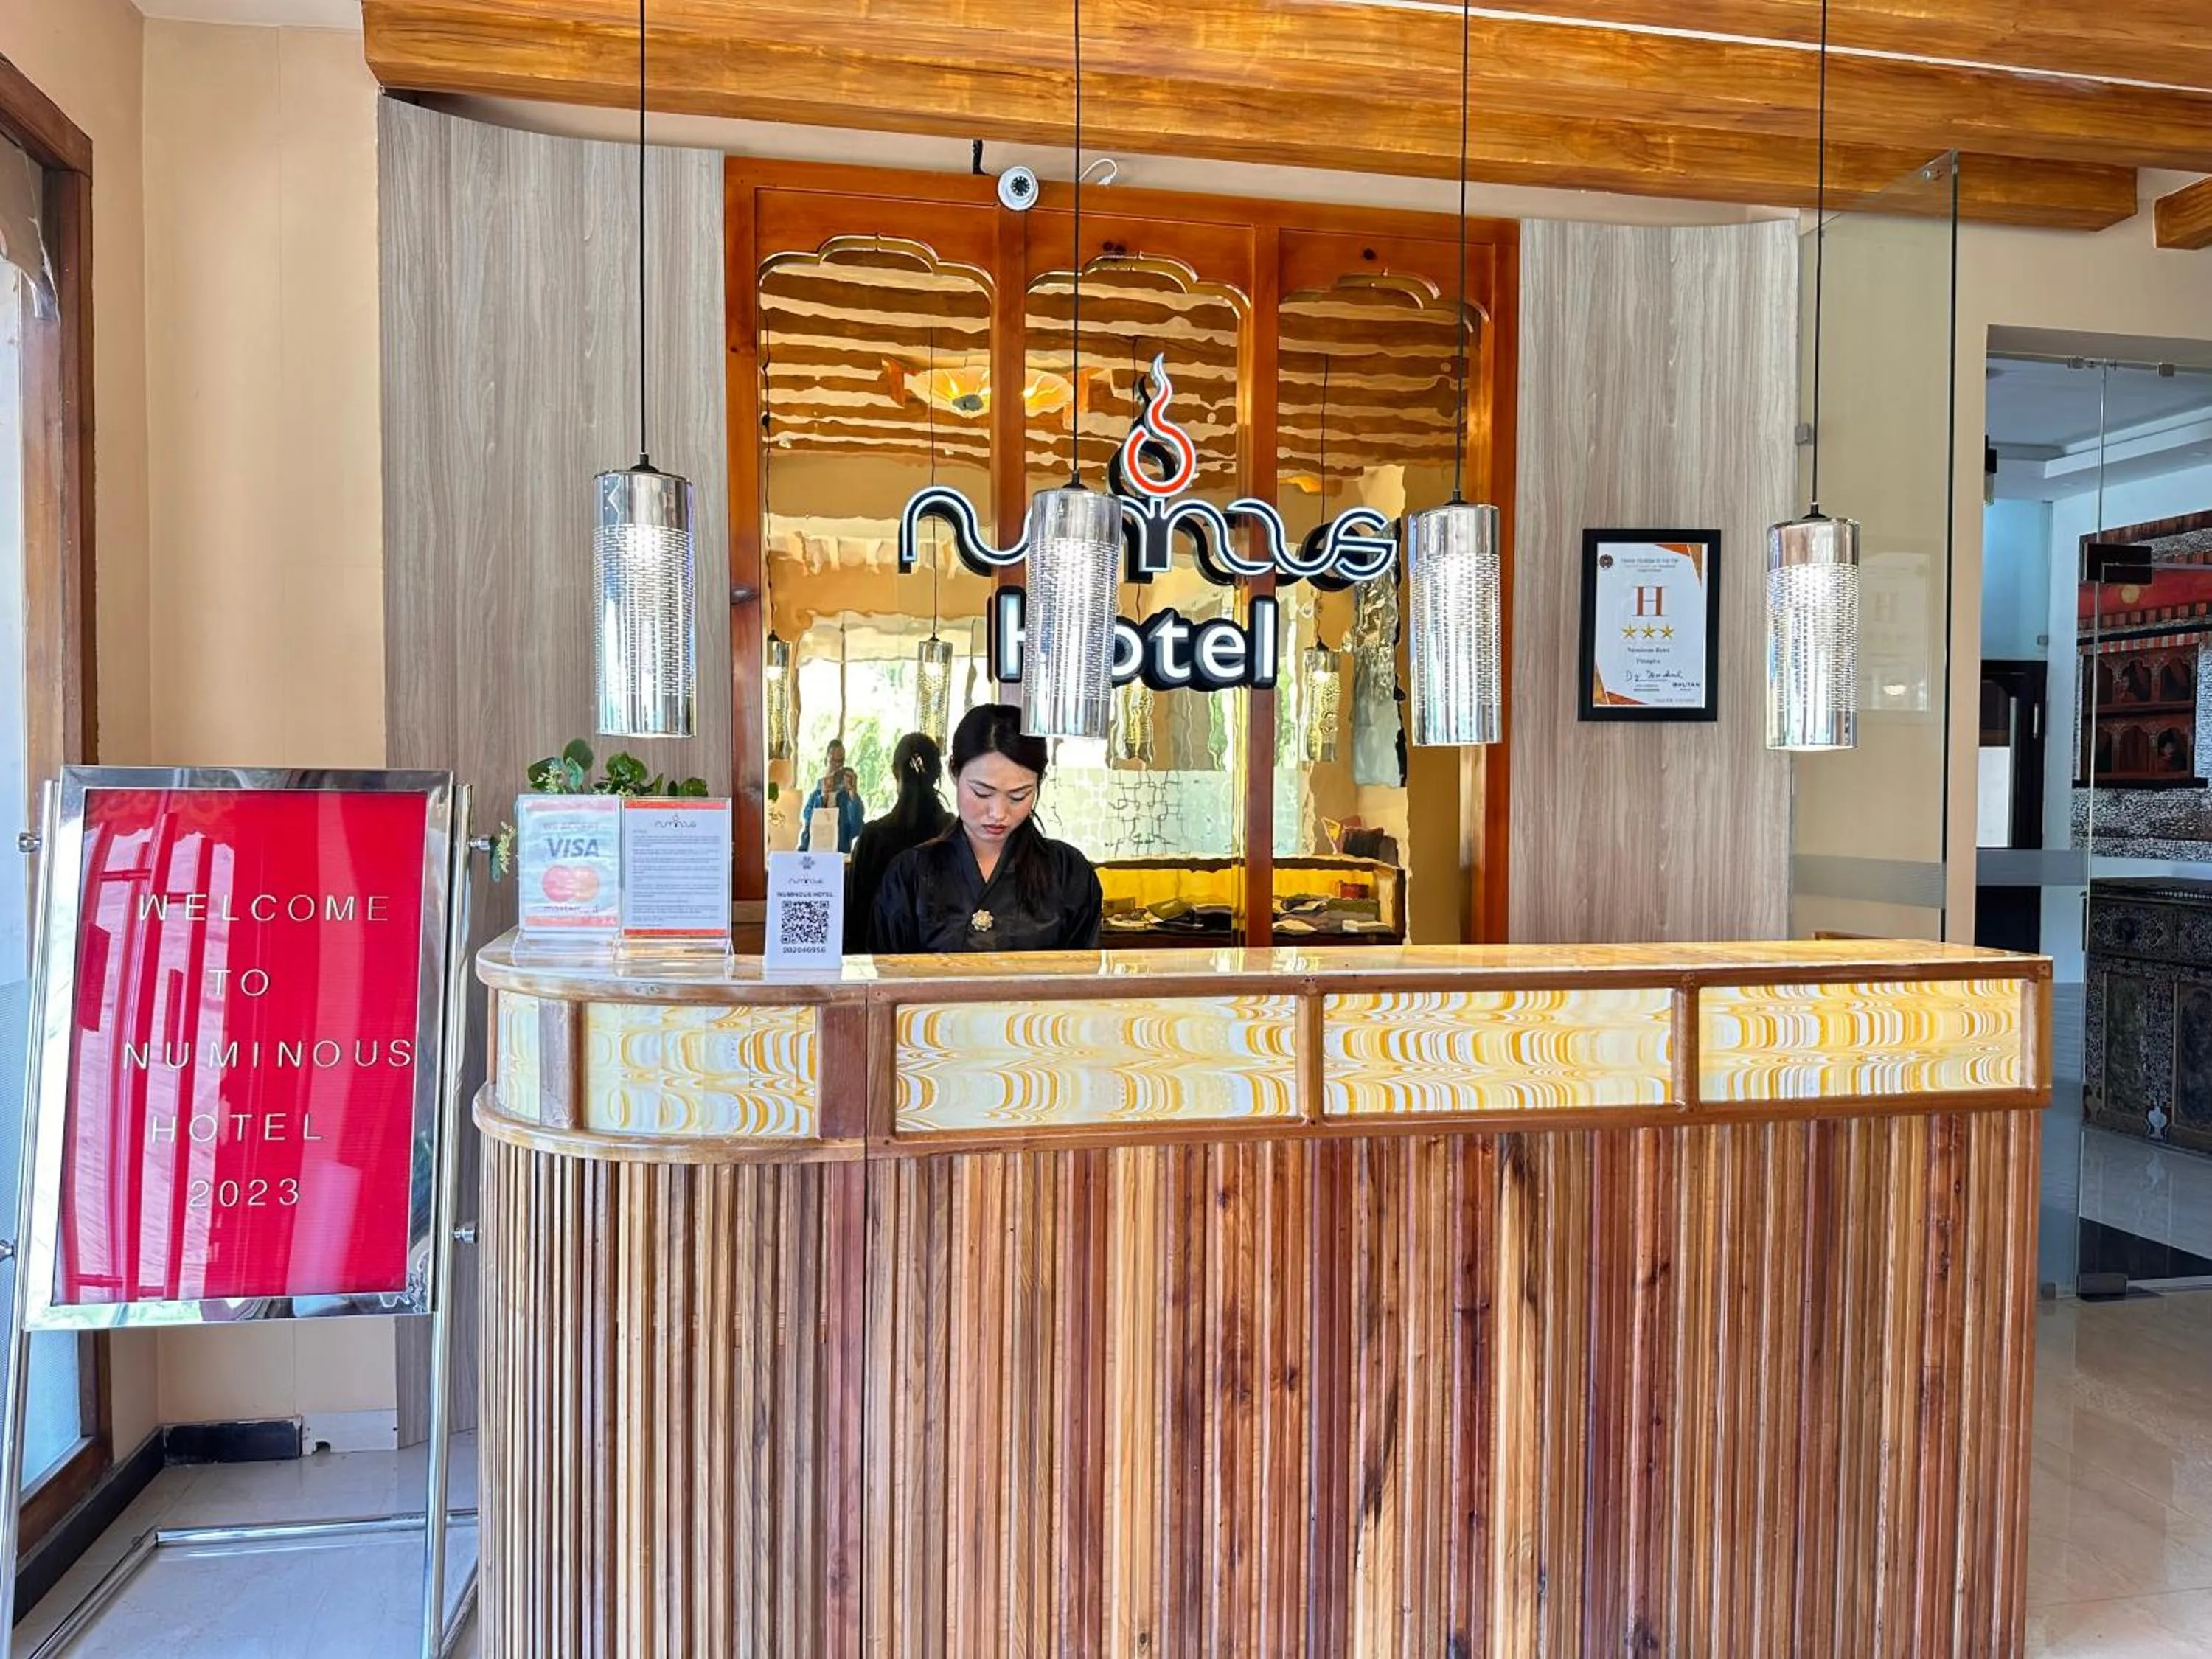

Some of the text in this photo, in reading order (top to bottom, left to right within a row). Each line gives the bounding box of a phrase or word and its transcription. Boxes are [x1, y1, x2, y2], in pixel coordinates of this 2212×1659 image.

[902, 422, 1397, 581] nuinous
[1632, 586, 1668, 616] H
[546, 838, 600, 858] VISA
[138, 893, 390, 922] WELCOME
[207, 968, 271, 997] TO
[122, 1039, 413, 1069] NUMINOUS
[151, 1113, 323, 1144] HOTEL
[188, 1178, 301, 1208] 2023
